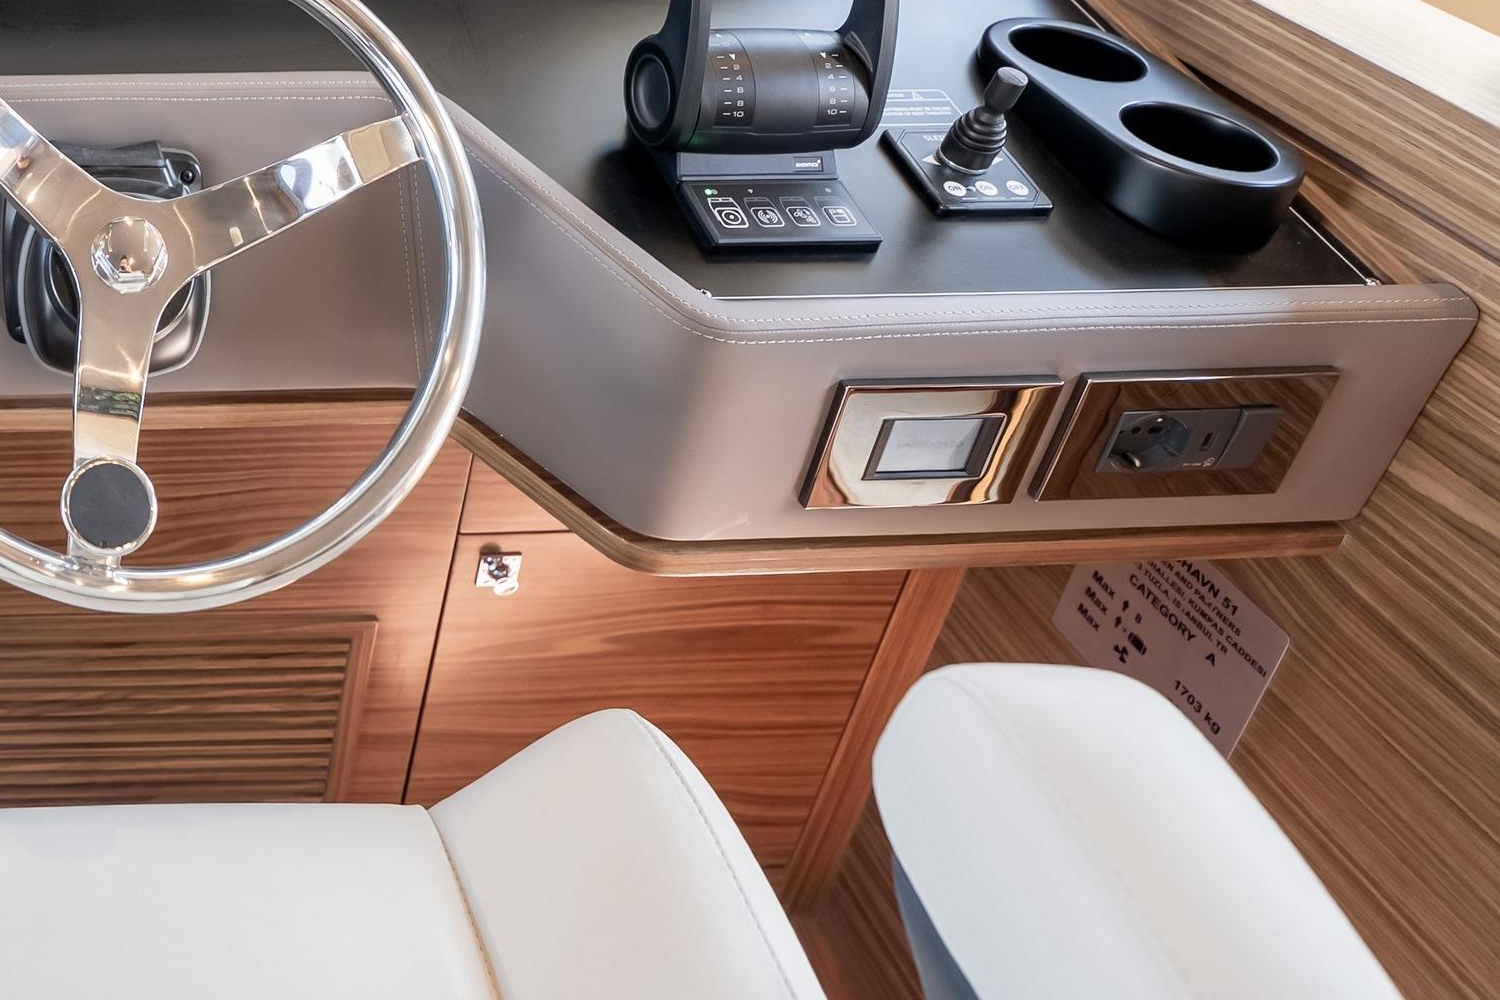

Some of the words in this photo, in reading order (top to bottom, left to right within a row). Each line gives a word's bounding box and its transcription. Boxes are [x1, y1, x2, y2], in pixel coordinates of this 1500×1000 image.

[732, 110, 744, 118] 10
[1092, 569, 1116, 600] Max
[1174, 570, 1194, 590] AND
[1177, 560, 1220, 598] HAVN
[1221, 596, 1239, 616] 51
[1077, 602, 1100, 632] Max
[1129, 573, 1197, 642] CATEGORY
[1205, 653, 1216, 667] A
[1085, 585, 1109, 616] Max
[1174, 680, 1203, 714] 1703
[1204, 712, 1221, 735] kg
[1215, 639, 1229, 656] TR
[1225, 635, 1268, 678] CADDESI
